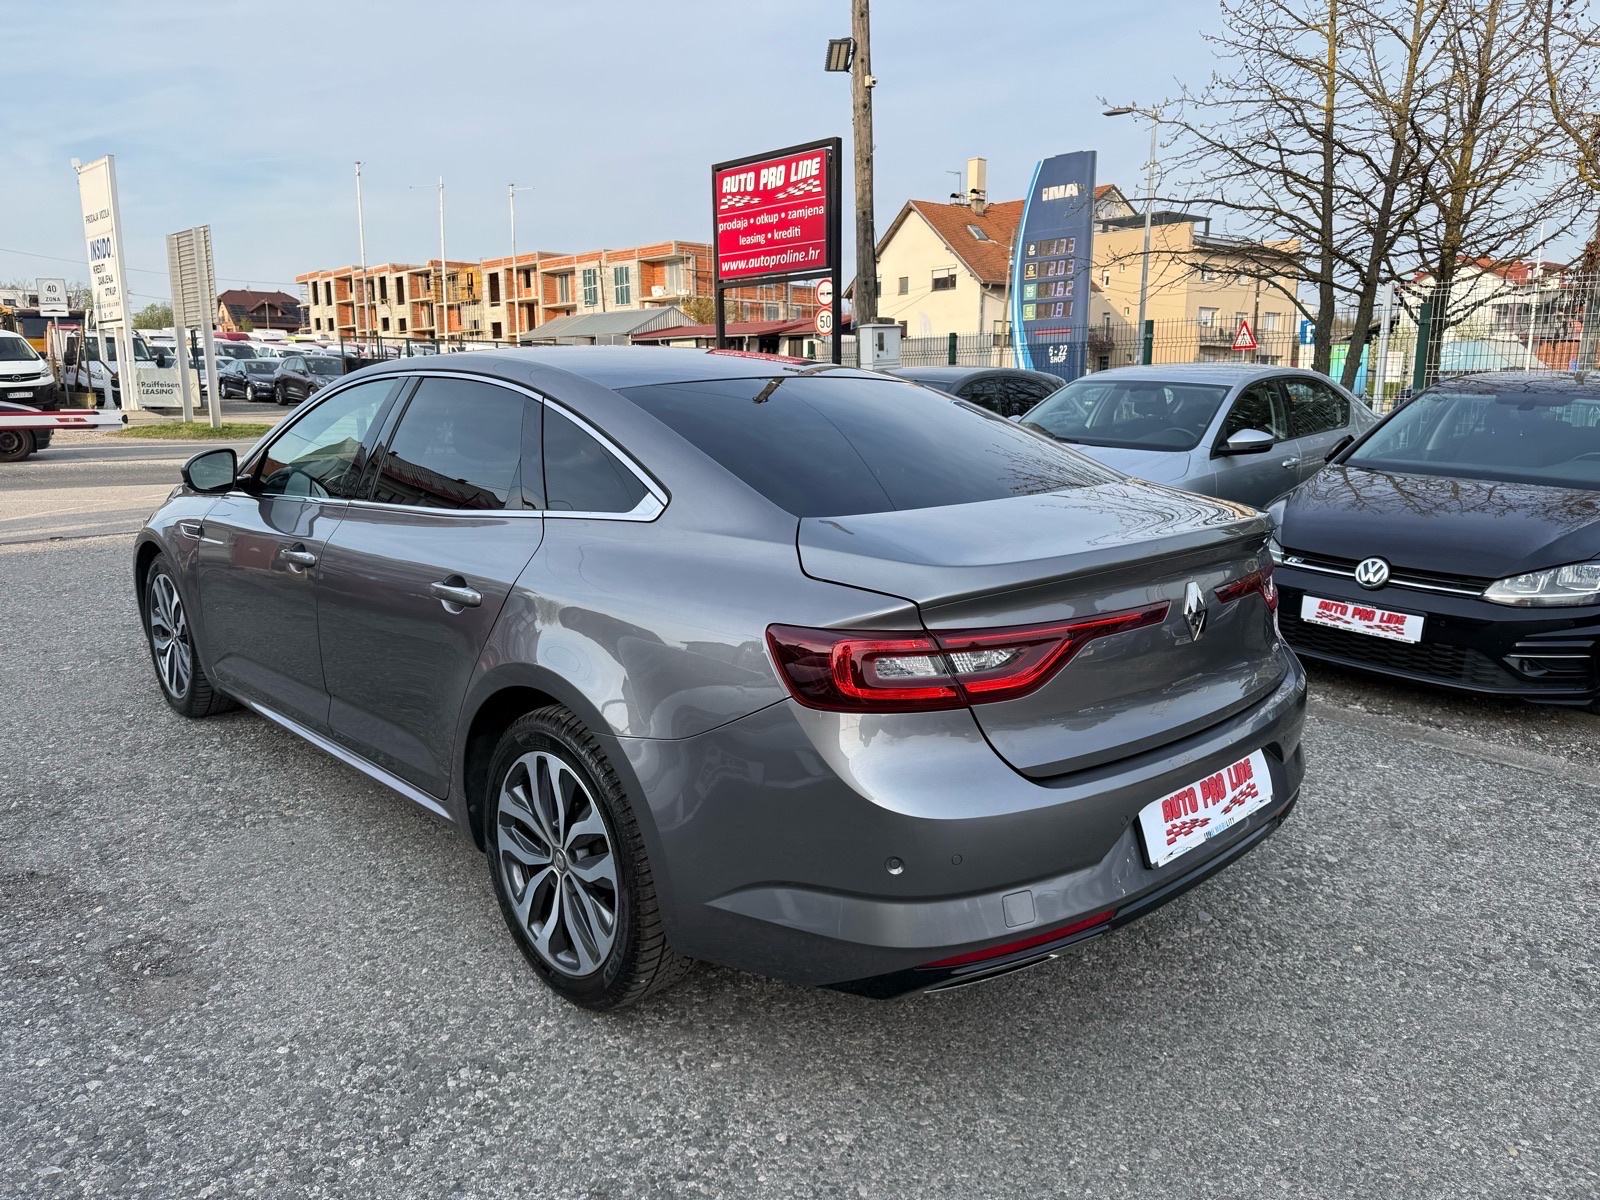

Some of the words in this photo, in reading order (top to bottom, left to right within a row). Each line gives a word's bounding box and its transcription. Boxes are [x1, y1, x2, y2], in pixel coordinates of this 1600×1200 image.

[722, 172, 755, 193] AUTO
[759, 164, 786, 190] PRO
[790, 157, 820, 182] LINE
[719, 218, 748, 233] prodaja
[756, 212, 779, 226] otkup
[787, 204, 824, 220] zamjena
[739, 233, 766, 246] leasing
[773, 225, 801, 241] krediti
[90, 237, 112, 261] INSIDO
[721, 248, 820, 271] www.autoproline.hr
[46, 285, 57, 293] 40
[819, 316, 832, 328] 50
[1050, 355, 1066, 363] SHOP
[1059, 345, 1068, 356] 22
[1318, 600, 1348, 616] AUTO
[1351, 607, 1376, 622] PRO
[1379, 612, 1407, 625] LINE
[1162, 787, 1198, 822] AUTO
[1200, 772, 1227, 808] PRO
[1227, 757, 1254, 792] LINE
